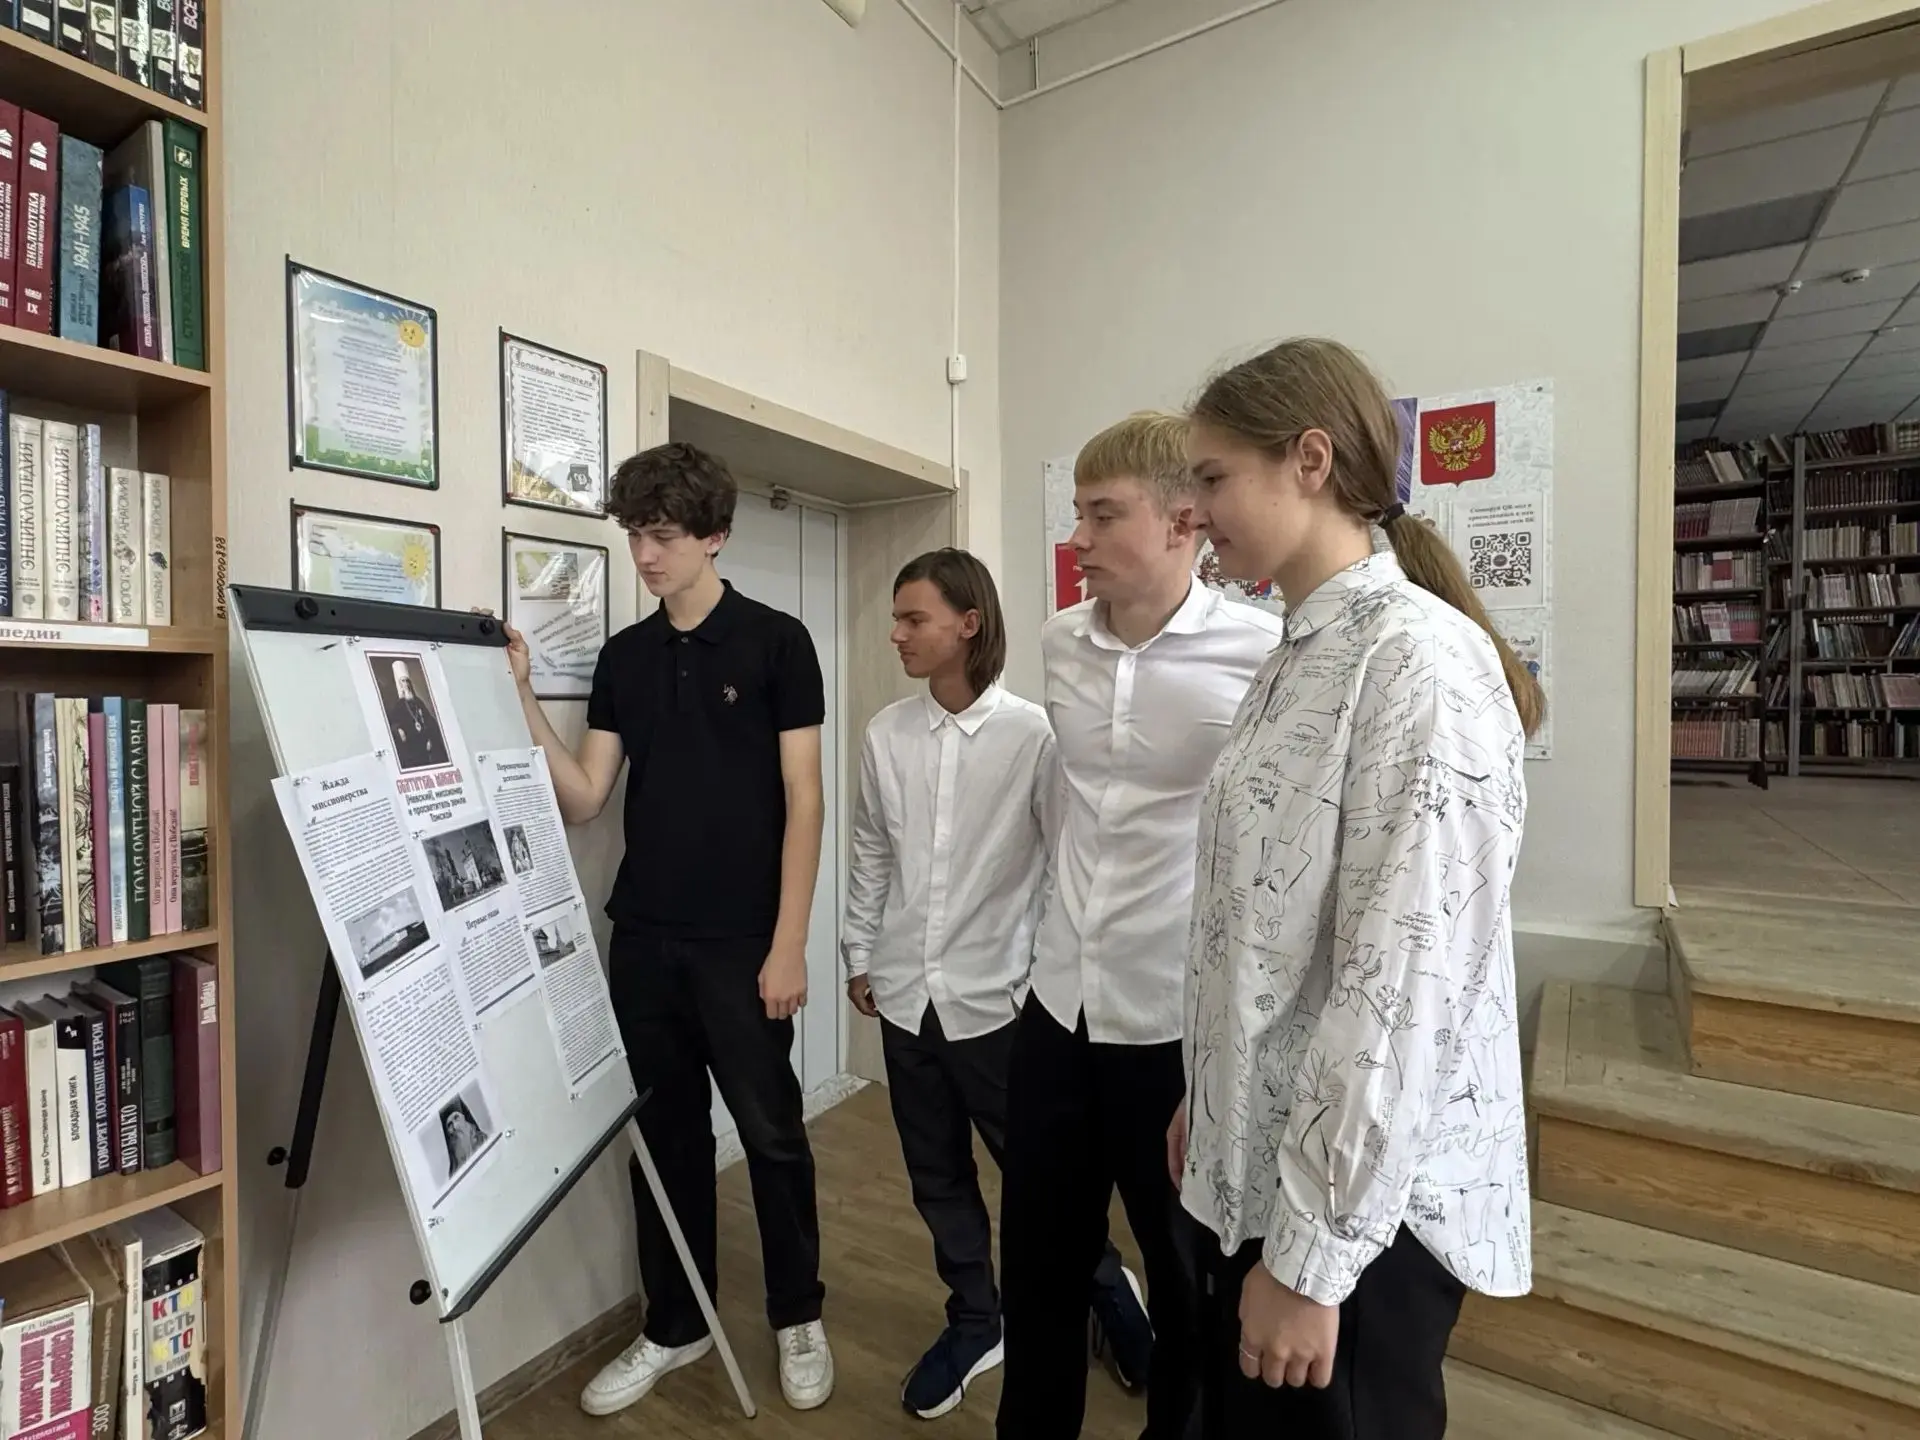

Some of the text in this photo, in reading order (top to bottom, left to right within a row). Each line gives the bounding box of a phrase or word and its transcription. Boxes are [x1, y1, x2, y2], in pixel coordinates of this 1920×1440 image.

[26, 192, 39, 268] БИБЛИОТЕКА
[73, 204, 90, 270] 1941-1945
[180, 175, 190, 248] ВРЕМЯ ПЕРВЫХ
[18, 441, 35, 571] ЭНЦИКЛОПЕДИЯ
[55, 446, 70, 574] ЭНЦИКЛОПЕДИЯ
[117, 476, 129, 531] АНАТОМИЯ
[130, 719, 144, 780] СЛАВЫ
[311, 788, 369, 811] миссионерства
[320, 777, 350, 791] Жажда
[134, 856, 144, 903] ПОЛЯ
[68, 1075, 80, 1142] БЛОКАДНАЯ КНИГА
[92, 1022, 109, 1169] ГОВОРЯТ ПОГИБШИЕ ГЕРОИ
[120, 1104, 137, 1124] КТО
[121, 1147, 138, 1168] КТО
[152, 1285, 195, 1321] КТО
[153, 1311, 196, 1341] ЕСТЬ
[92, 1404, 110, 1436] 3000
